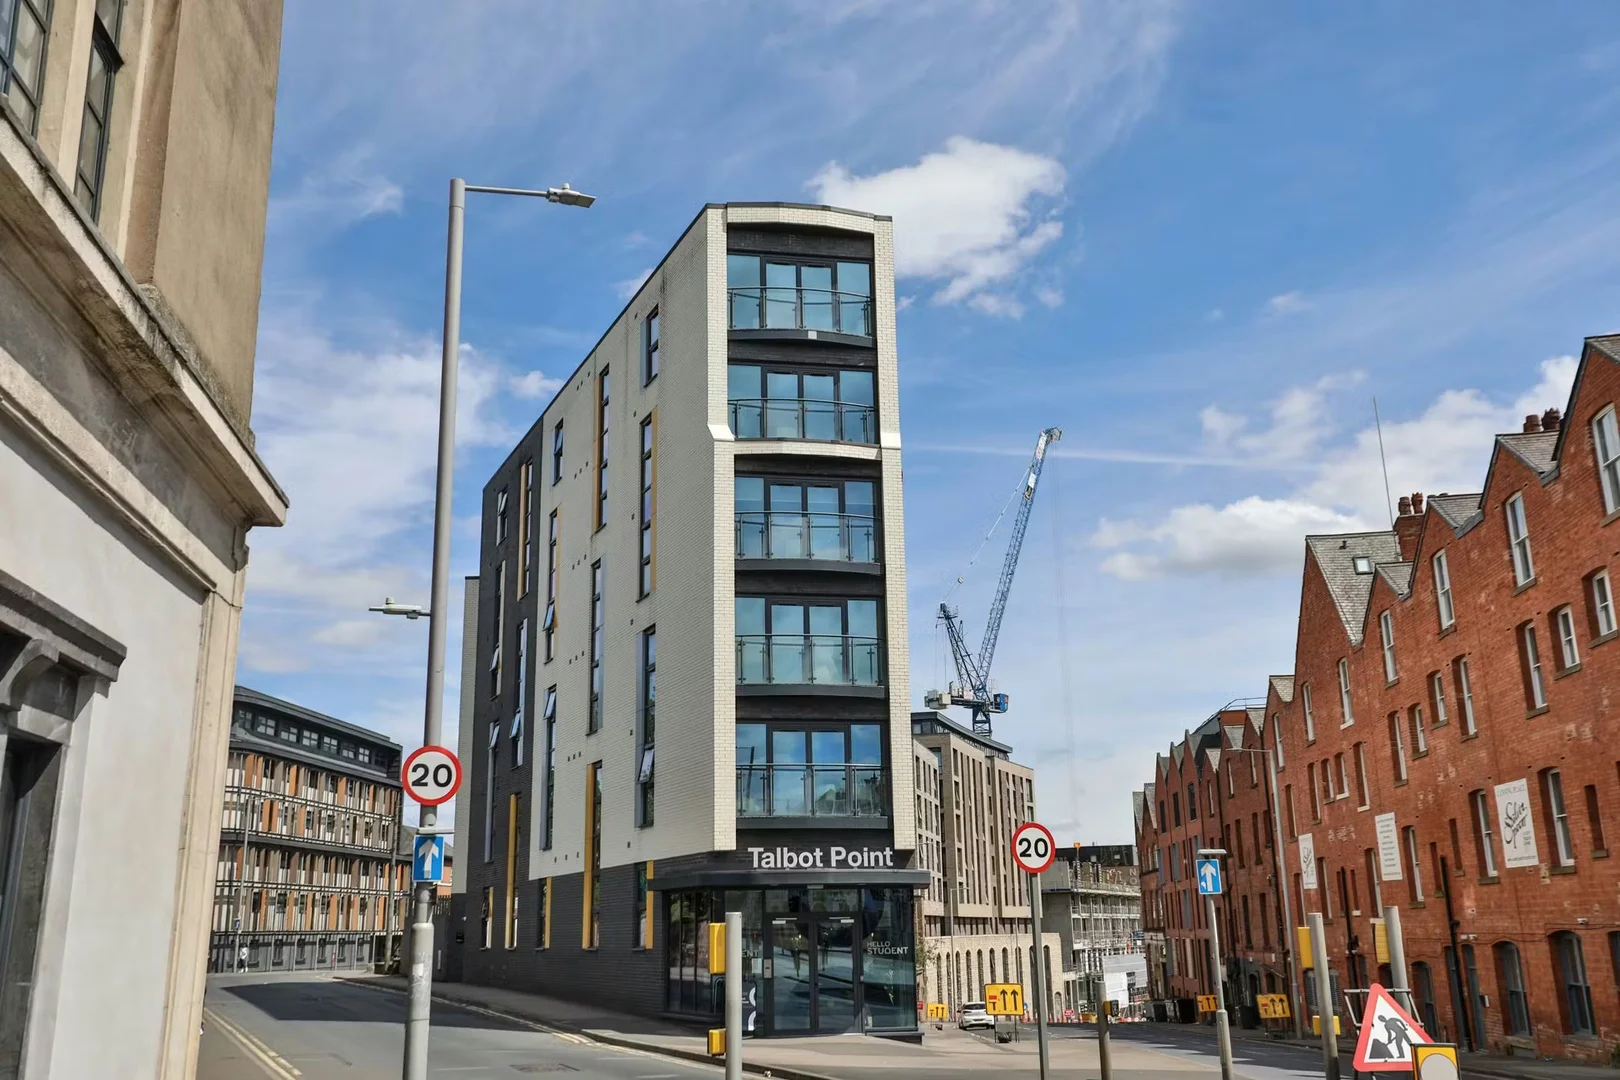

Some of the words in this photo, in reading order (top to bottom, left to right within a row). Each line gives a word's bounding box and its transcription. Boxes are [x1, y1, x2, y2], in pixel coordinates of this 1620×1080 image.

[411, 763, 453, 788] 20
[747, 847, 824, 869] Talbot
[830, 846, 894, 868] Point
[1018, 837, 1049, 858] 20
[867, 940, 891, 948] HELLO
[867, 946, 909, 955] STUDENT
